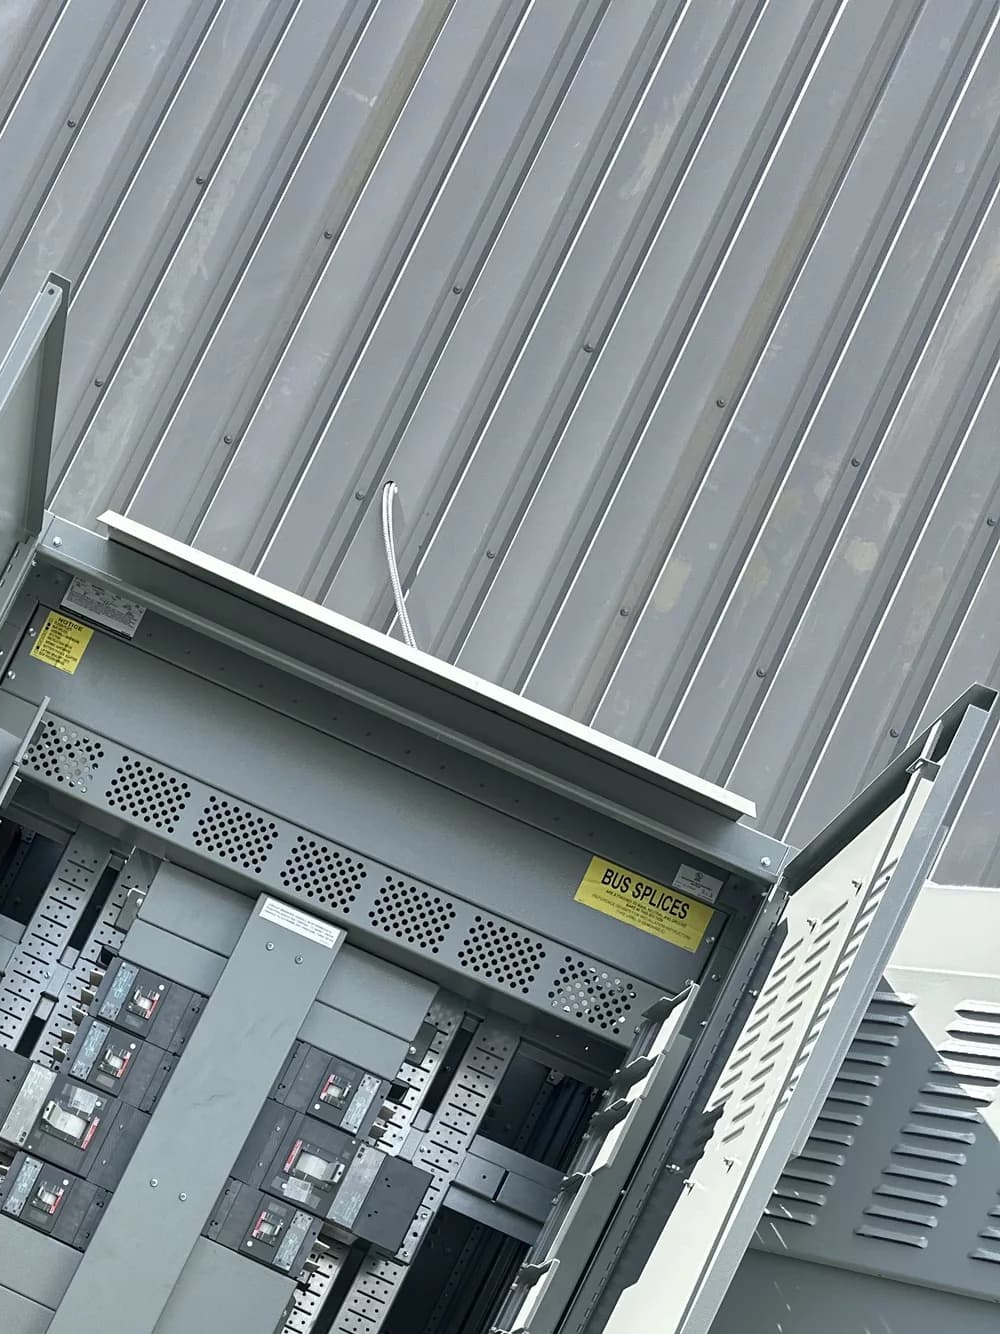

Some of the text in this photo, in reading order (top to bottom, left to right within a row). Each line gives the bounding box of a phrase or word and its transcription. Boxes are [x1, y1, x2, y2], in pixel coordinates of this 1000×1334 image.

[57, 617, 83, 632] NOTICE
[601, 868, 631, 893] BUS
[632, 882, 690, 919] SPLICES
